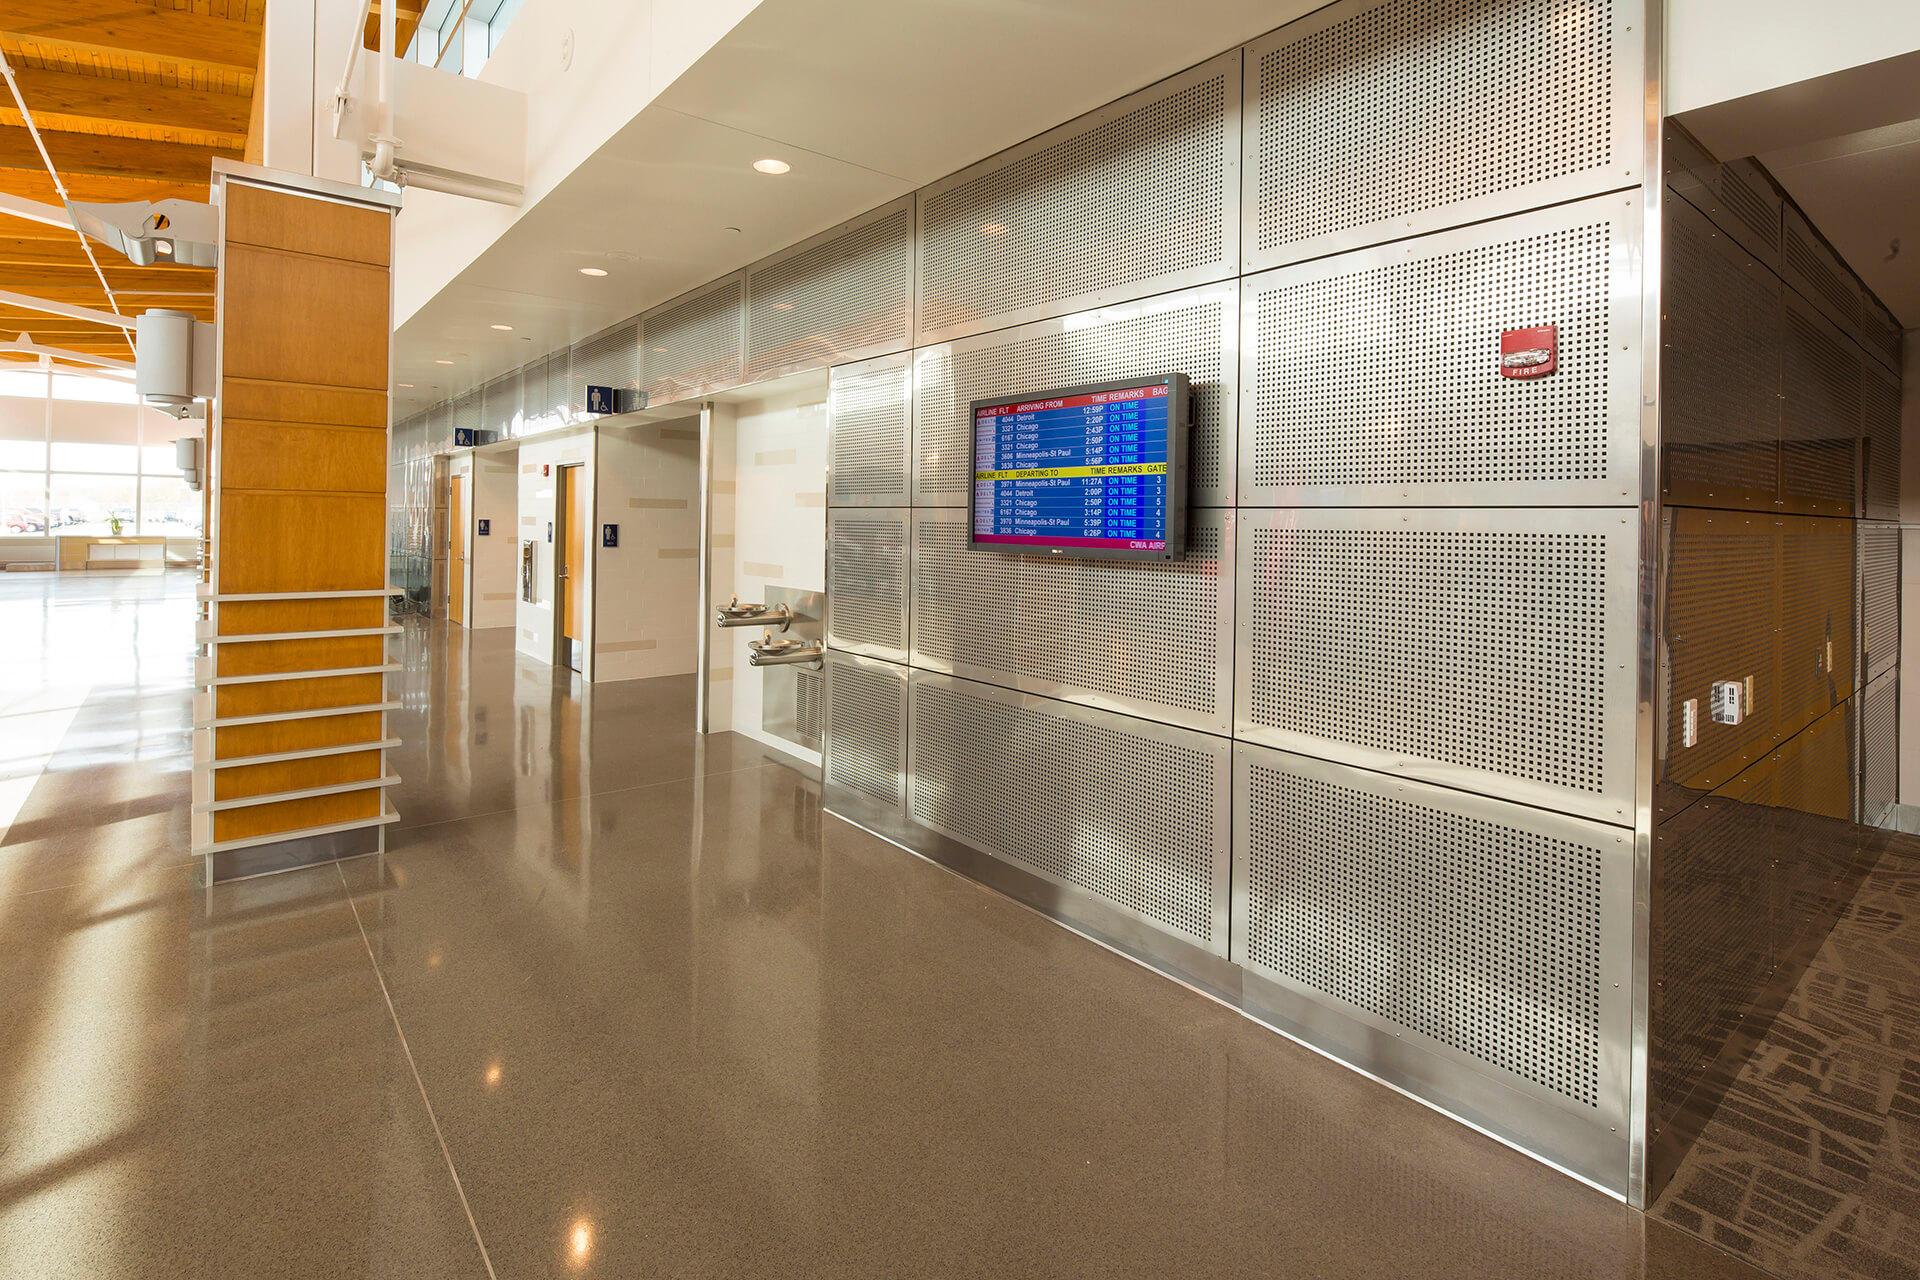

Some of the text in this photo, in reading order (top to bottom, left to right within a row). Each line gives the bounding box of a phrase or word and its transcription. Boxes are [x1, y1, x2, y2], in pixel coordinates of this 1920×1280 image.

[1512, 366, 1538, 376] FIRE
[977, 408, 996, 416] AIRLINE
[1016, 402, 1044, 412] ARRIVING
[1045, 400, 1063, 408] FROM
[1092, 394, 1107, 402] TIME
[1109, 390, 1144, 400] REMARKS
[1152, 386, 1168, 396] BAG
[1082, 406, 1104, 414] 12:59P
[1122, 401, 1138, 410] TIME
[1016, 424, 1038, 432] Chicago
[1086, 416, 1104, 424] 2:20P
[1122, 412, 1138, 420] TIME
[1016, 434, 1038, 442] Chicago
[1086, 426, 1104, 434] 2:43P
[1122, 423, 1138, 431] TIME
[1016, 442, 1038, 450] Chicago
[1086, 436, 1104, 444] 2:50P
[1122, 434, 1138, 442] TIME
[1016, 450, 1056, 459] Minneapolis-St
[1086, 446, 1103, 454] 5:14P
[1122, 444, 1138, 452] TIME
[1016, 462, 1038, 470] Chicago
[1108, 466, 1142, 474] REMARKS
[1147, 464, 1166, 472] GATE
[1016, 480, 1056, 488] Minneapolis-St
[1156, 476, 1162, 484] 3
[1156, 486, 1161, 494] 3
[1015, 500, 1038, 508] Chicago
[1120, 498, 1137, 506] TIME
[1156, 498, 1160, 506] 5
[1015, 509, 1037, 517] Chicago
[1015, 518, 1055, 526] Minneapolis-St
[1014, 528, 1036, 536] Chicago
[1130, 541, 1147, 549] CWA
